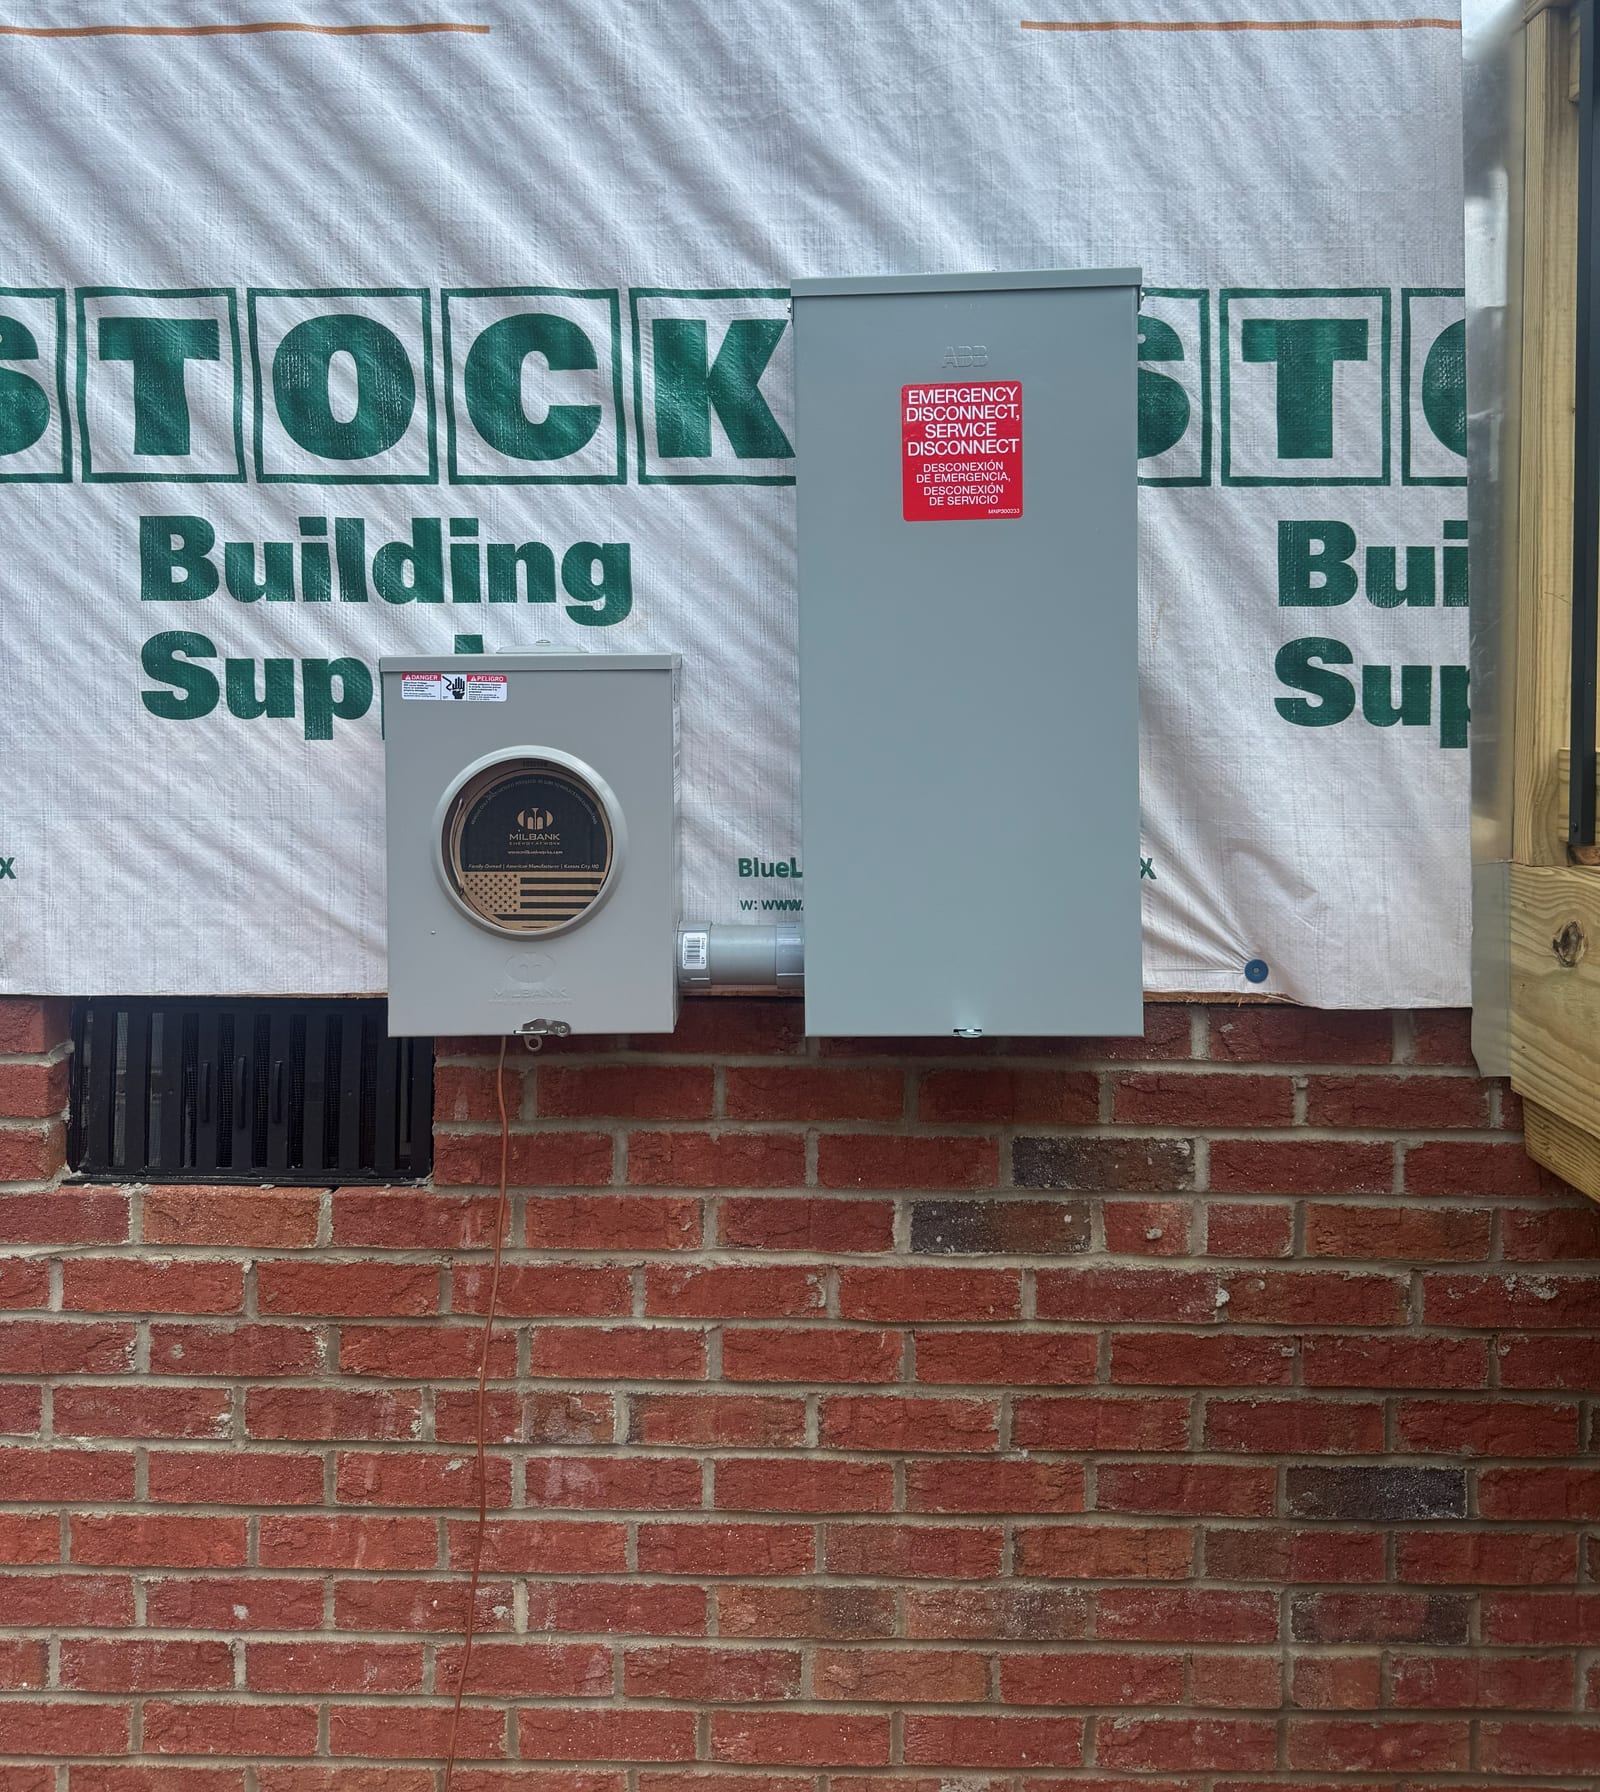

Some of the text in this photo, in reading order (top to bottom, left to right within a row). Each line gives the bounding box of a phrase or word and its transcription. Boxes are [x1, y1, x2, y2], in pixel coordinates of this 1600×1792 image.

[942, 345, 989, 368] ABB
[908, 387, 1018, 404] EMERGENCY
[906, 404, 1020, 422] DISCONNECT,
[925, 422, 997, 438] SERVICE
[908, 439, 1020, 456] DISCONNECT
[923, 460, 1004, 473] DESCONEXIÓN
[916, 471, 1011, 484] DE EMERGENCIA,
[923, 483, 1004, 496] DESCONEXIÓN
[929, 495, 999, 506] DE SERVICIO
[139, 515, 633, 626] Building
[140, 631, 484, 741] Sup
[509, 833, 561, 841] MILBANK
